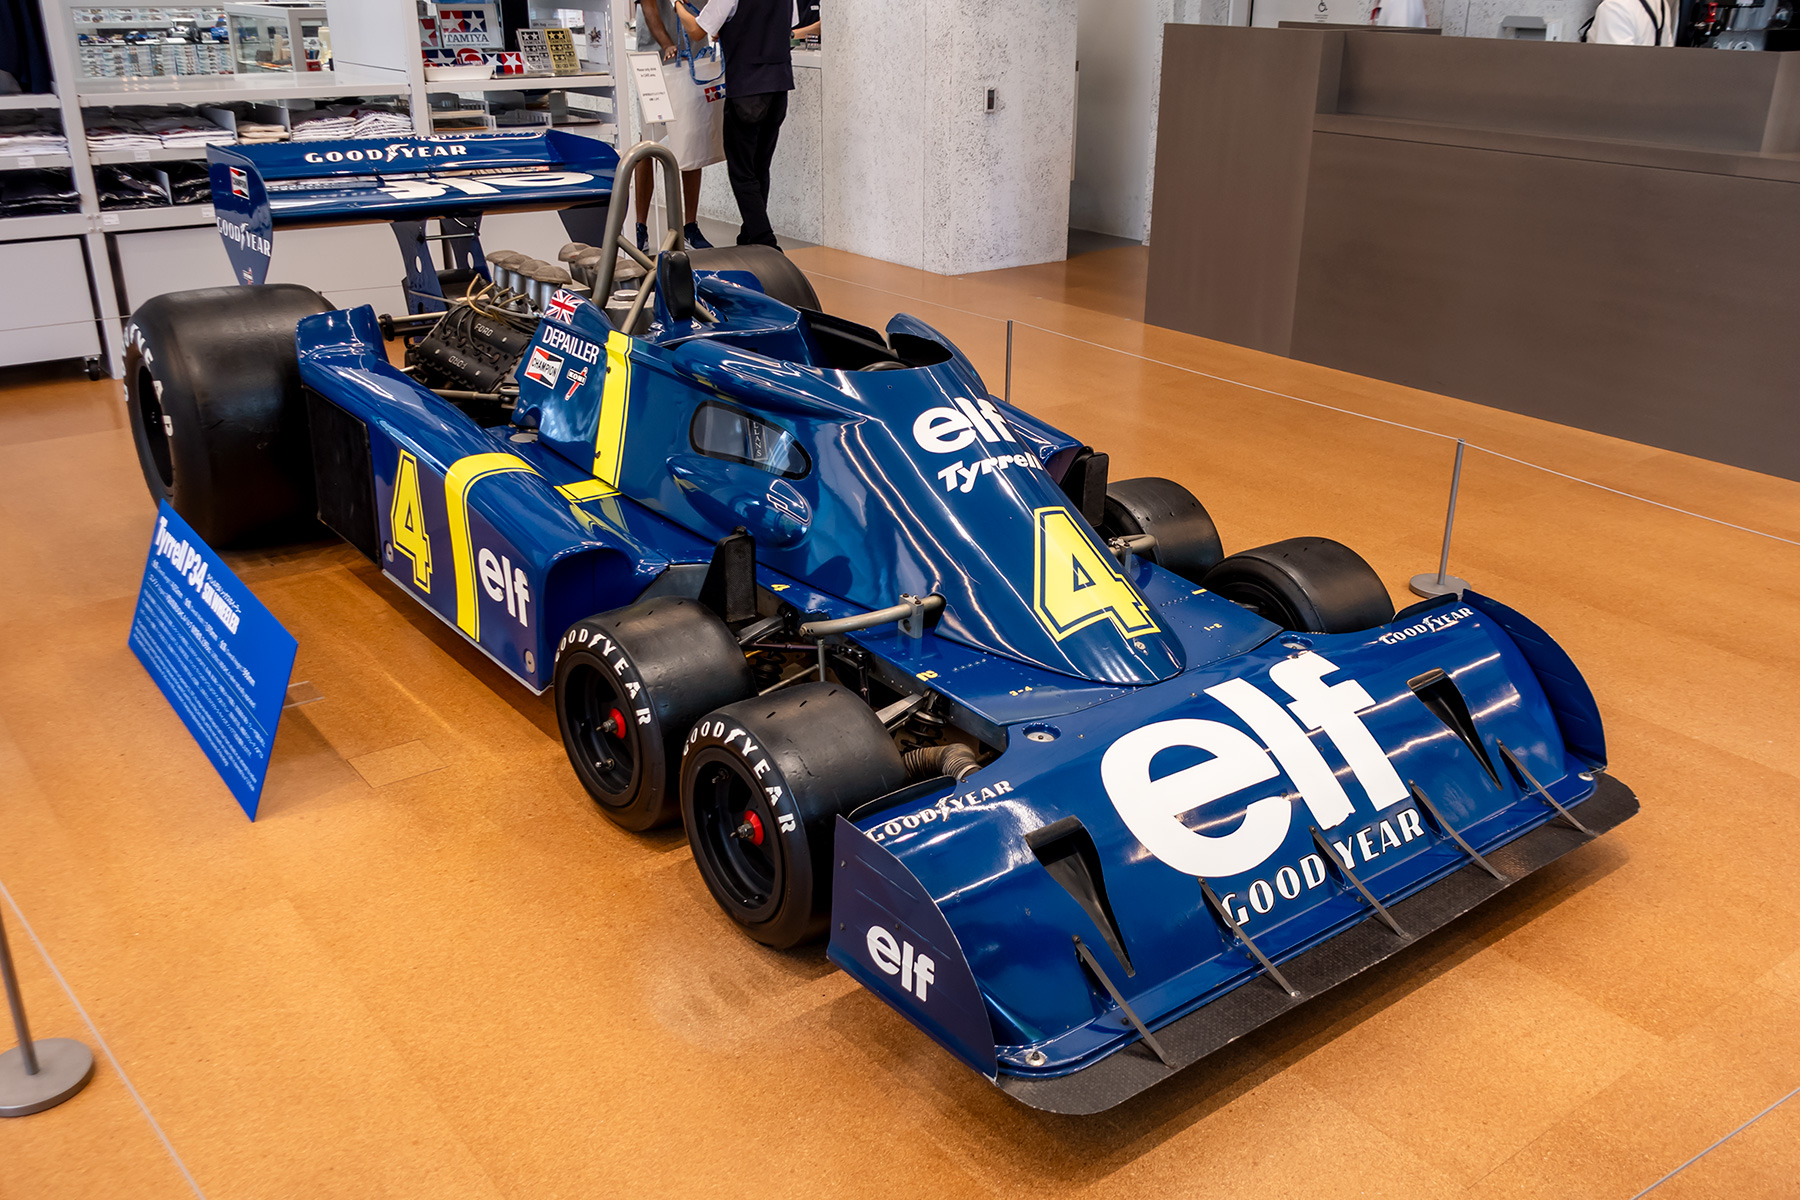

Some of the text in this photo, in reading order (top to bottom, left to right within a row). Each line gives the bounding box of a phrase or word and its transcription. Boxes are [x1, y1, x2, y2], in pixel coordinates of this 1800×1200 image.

[444, 33, 489, 43] TAMIYA
[474, 323, 494, 337] FORD
[542, 326, 599, 365] DEPAILLER
[448, 355, 468, 370] FORD
[530, 357, 559, 378] CHAMPION
[912, 396, 1016, 454] elf
[937, 452, 1044, 494] Tyrrell
[391, 449, 433, 594] 4
[155, 515, 189, 572] Tyrrell
[181, 546, 209, 593] P34
[210, 590, 240, 635] WHEELER
[478, 547, 531, 628] elf
[1033, 505, 1162, 643] 4
[1100, 650, 1410, 878] elf
[866, 925, 935, 1003] elf
